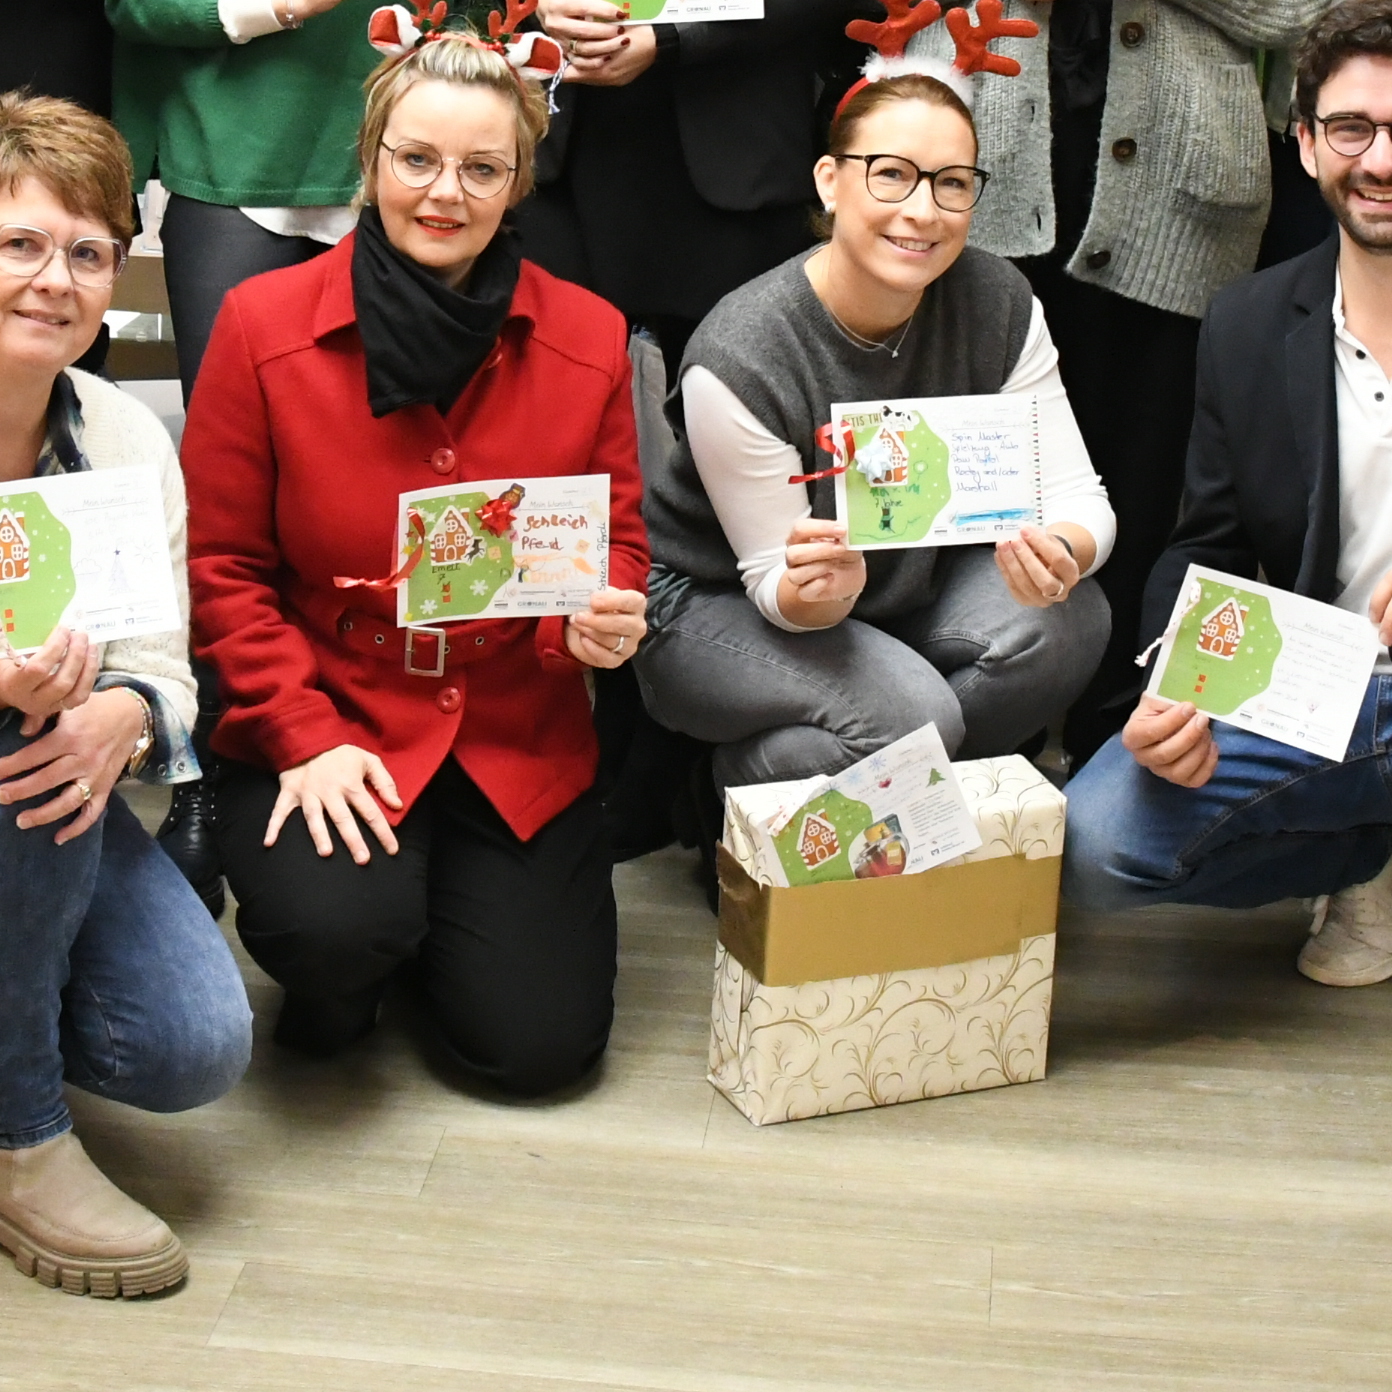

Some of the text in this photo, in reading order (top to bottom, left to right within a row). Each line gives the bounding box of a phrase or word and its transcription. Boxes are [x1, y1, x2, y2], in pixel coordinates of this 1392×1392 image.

[951, 432, 972, 443] Spin
[82, 497, 101, 508] Mein
[524, 514, 589, 533] Schleich
[85, 621, 116, 631] GRONAU
